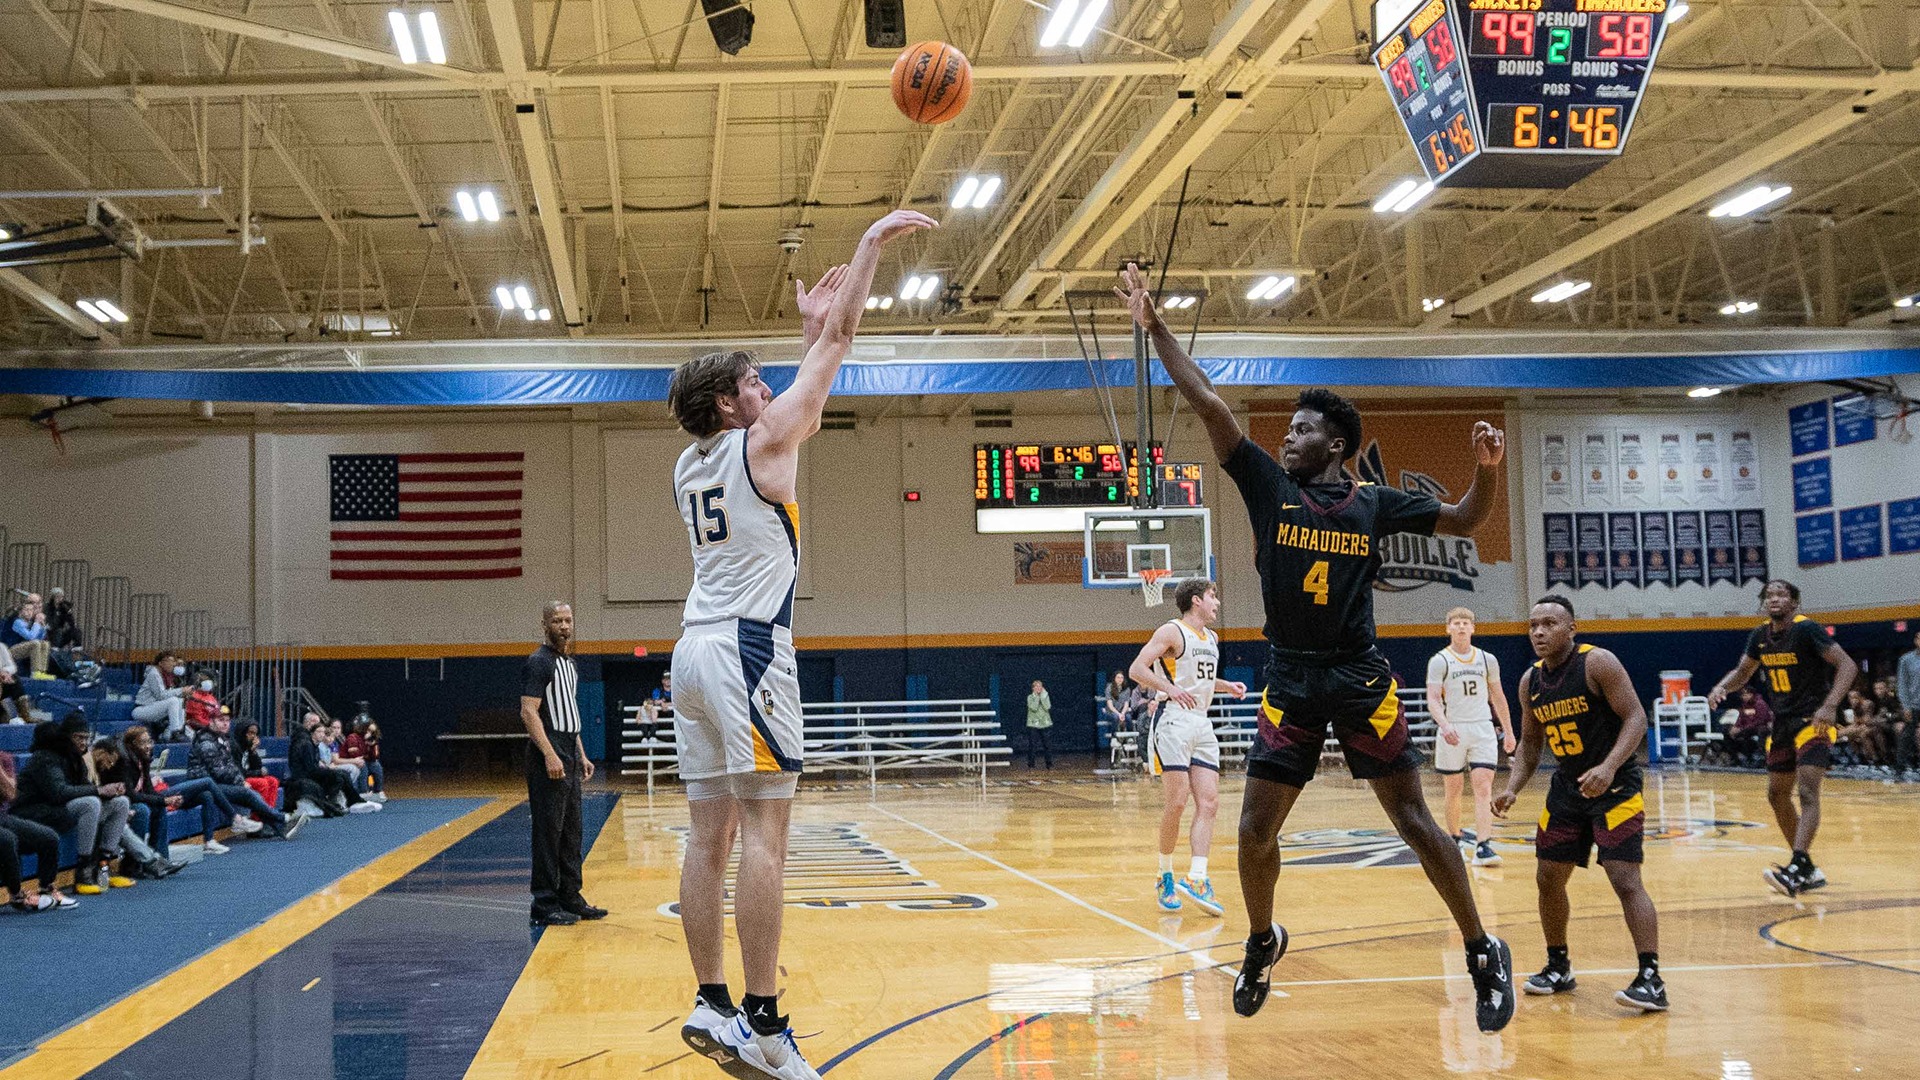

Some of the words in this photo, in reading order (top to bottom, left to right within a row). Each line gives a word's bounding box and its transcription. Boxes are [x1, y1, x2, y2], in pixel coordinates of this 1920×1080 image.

[1482, 12, 1534, 55] 99
[1537, 12, 1587, 27] PERIOD
[1426, 21, 1456, 72] 58
[1550, 28, 1571, 63] 2
[1598, 15, 1650, 57] 58
[911, 51, 932, 89] NCAA
[930, 55, 959, 105] Wilson
[1389, 56, 1418, 98] 99
[1415, 58, 1430, 90] 2
[1497, 60, 1544, 76] BONUS
[1572, 61, 1618, 77] BONUS
[1543, 83, 1570, 95] POSS
[1513, 106, 1619, 149] 6:46
[1019, 455, 1040, 472] 99
[1054, 446, 1093, 463] 6:46
[1075, 466, 1084, 480] 2
[1030, 487, 1040, 502] 2
[1108, 486, 1117, 501] 2
[1179, 482, 1196, 506] 7
[688, 483, 731, 550] 15
[1277, 523, 1370, 556] MARAUDERS
[1303, 561, 1329, 605] 4
[1197, 661, 1214, 680] 52
[1769, 669, 1791, 692] 10
[1462, 680, 1477, 695] 12
[1546, 721, 1584, 757] 25
